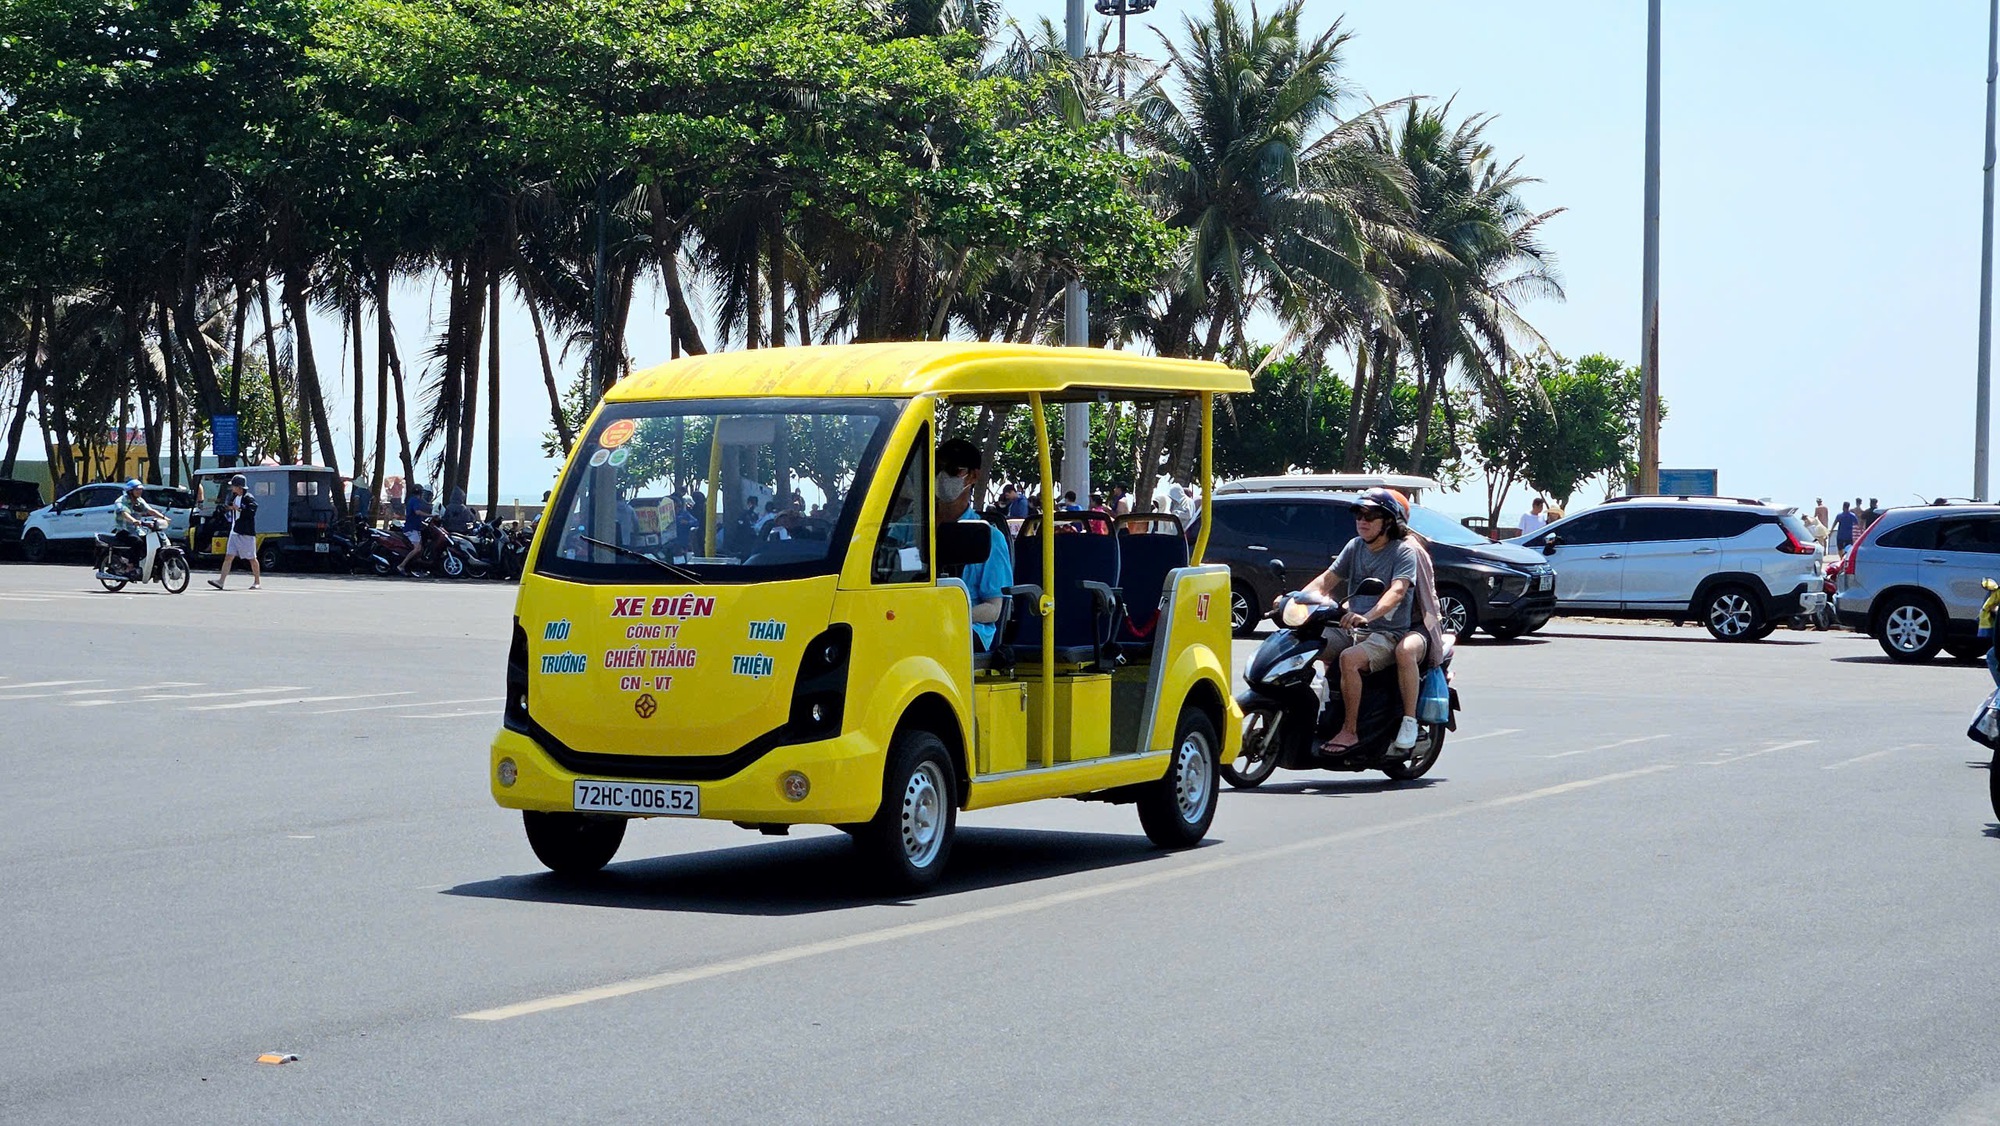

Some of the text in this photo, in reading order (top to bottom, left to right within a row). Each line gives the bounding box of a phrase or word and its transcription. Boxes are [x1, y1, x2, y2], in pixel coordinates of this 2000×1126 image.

[611, 593, 715, 620] XE ĐIỆN
[1197, 593, 1210, 622] 47
[544, 619, 571, 640] MÔI
[626, 623, 680, 639] CÔNG TY
[749, 618, 786, 640] THÂN
[541, 650, 587, 673] TRƯỜNG
[604, 643, 696, 668] CHIẾN THẮNG
[732, 653, 773, 679] THIỆN
[620, 676, 641, 690] CN
[655, 676, 673, 690] VT
[579, 785, 694, 810] 72HC-006.52
